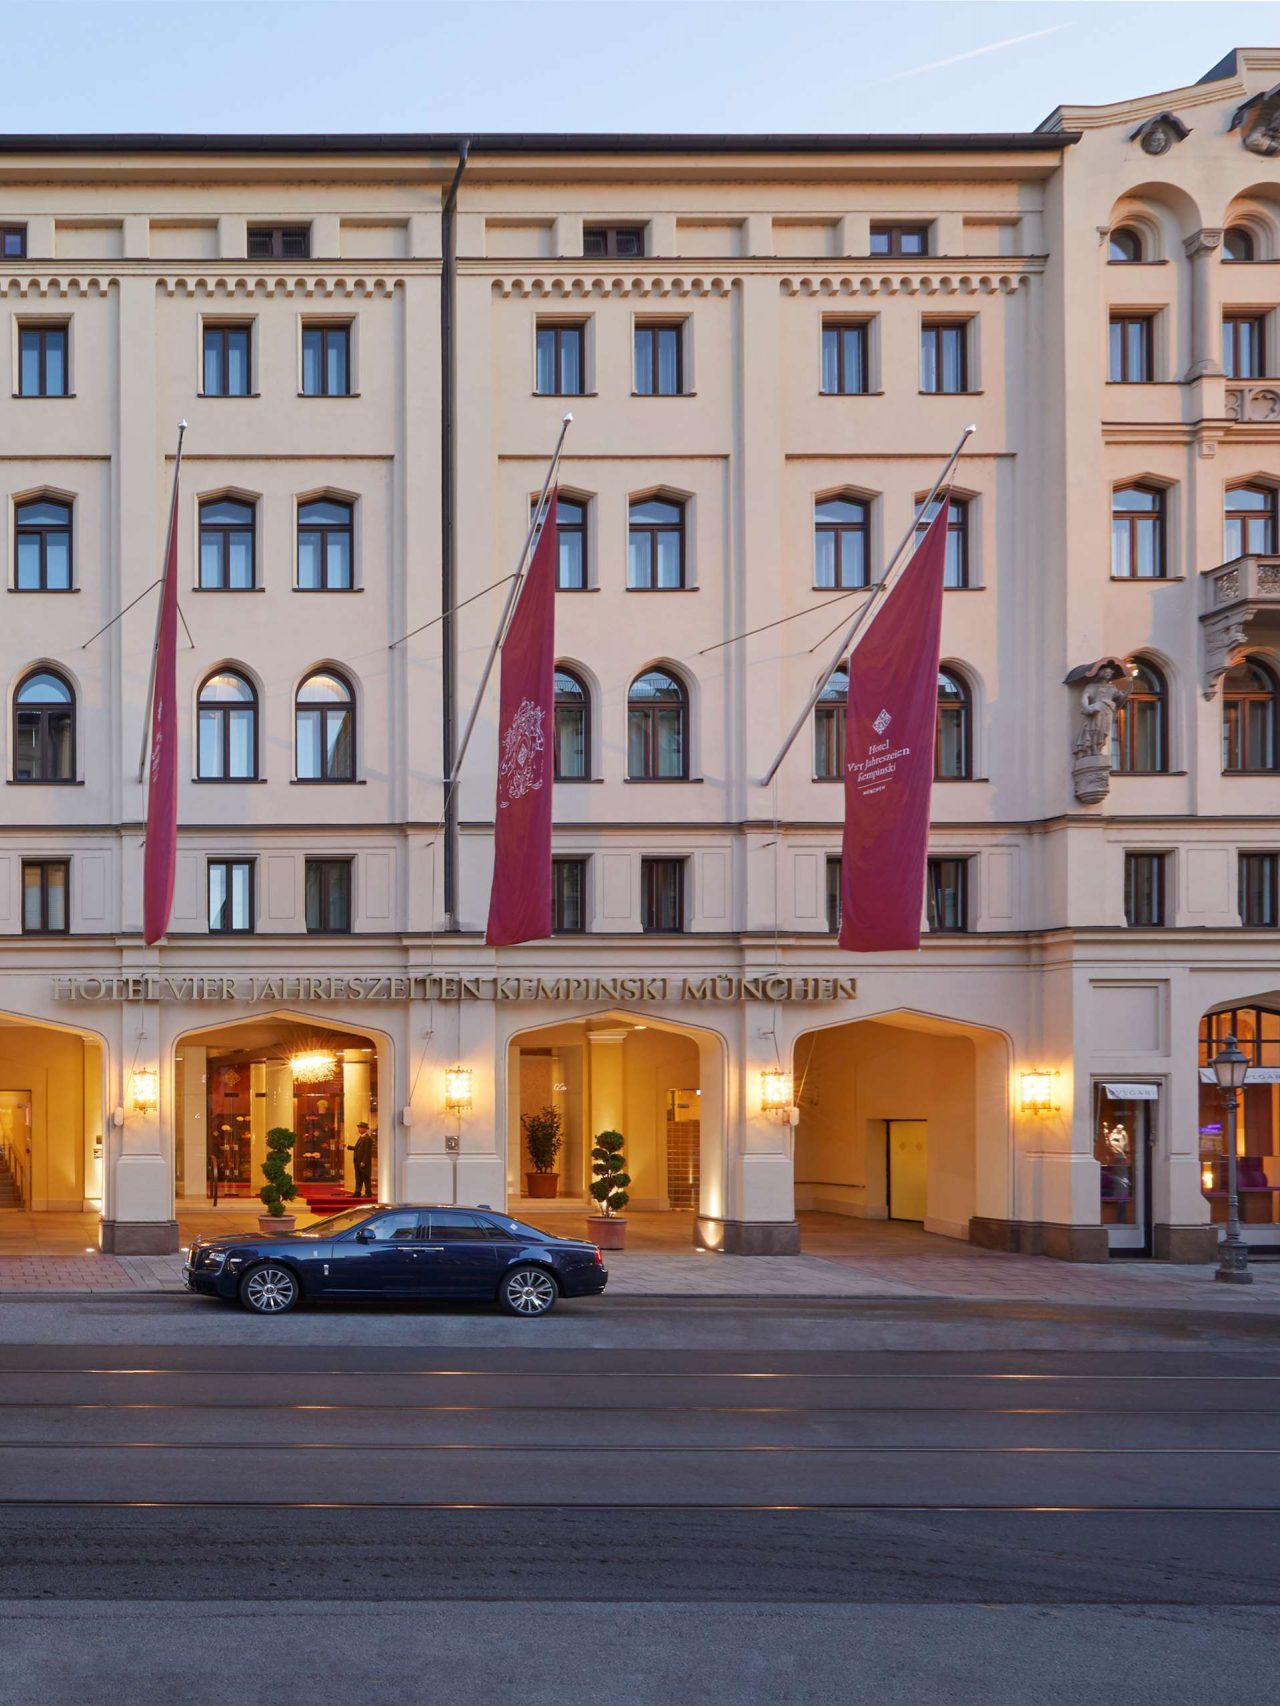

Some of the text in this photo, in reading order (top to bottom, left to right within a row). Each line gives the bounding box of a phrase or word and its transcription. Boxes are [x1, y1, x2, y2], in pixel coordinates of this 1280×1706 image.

[868, 739, 889, 755] Hotel
[847, 747, 910, 772] Vier Jahreszeiten
[857, 762, 896, 782] Kempinski
[52, 974, 859, 1004] HOTEL VIER JAHRESZEITEN KEMPINSKI MÜNCHEN
